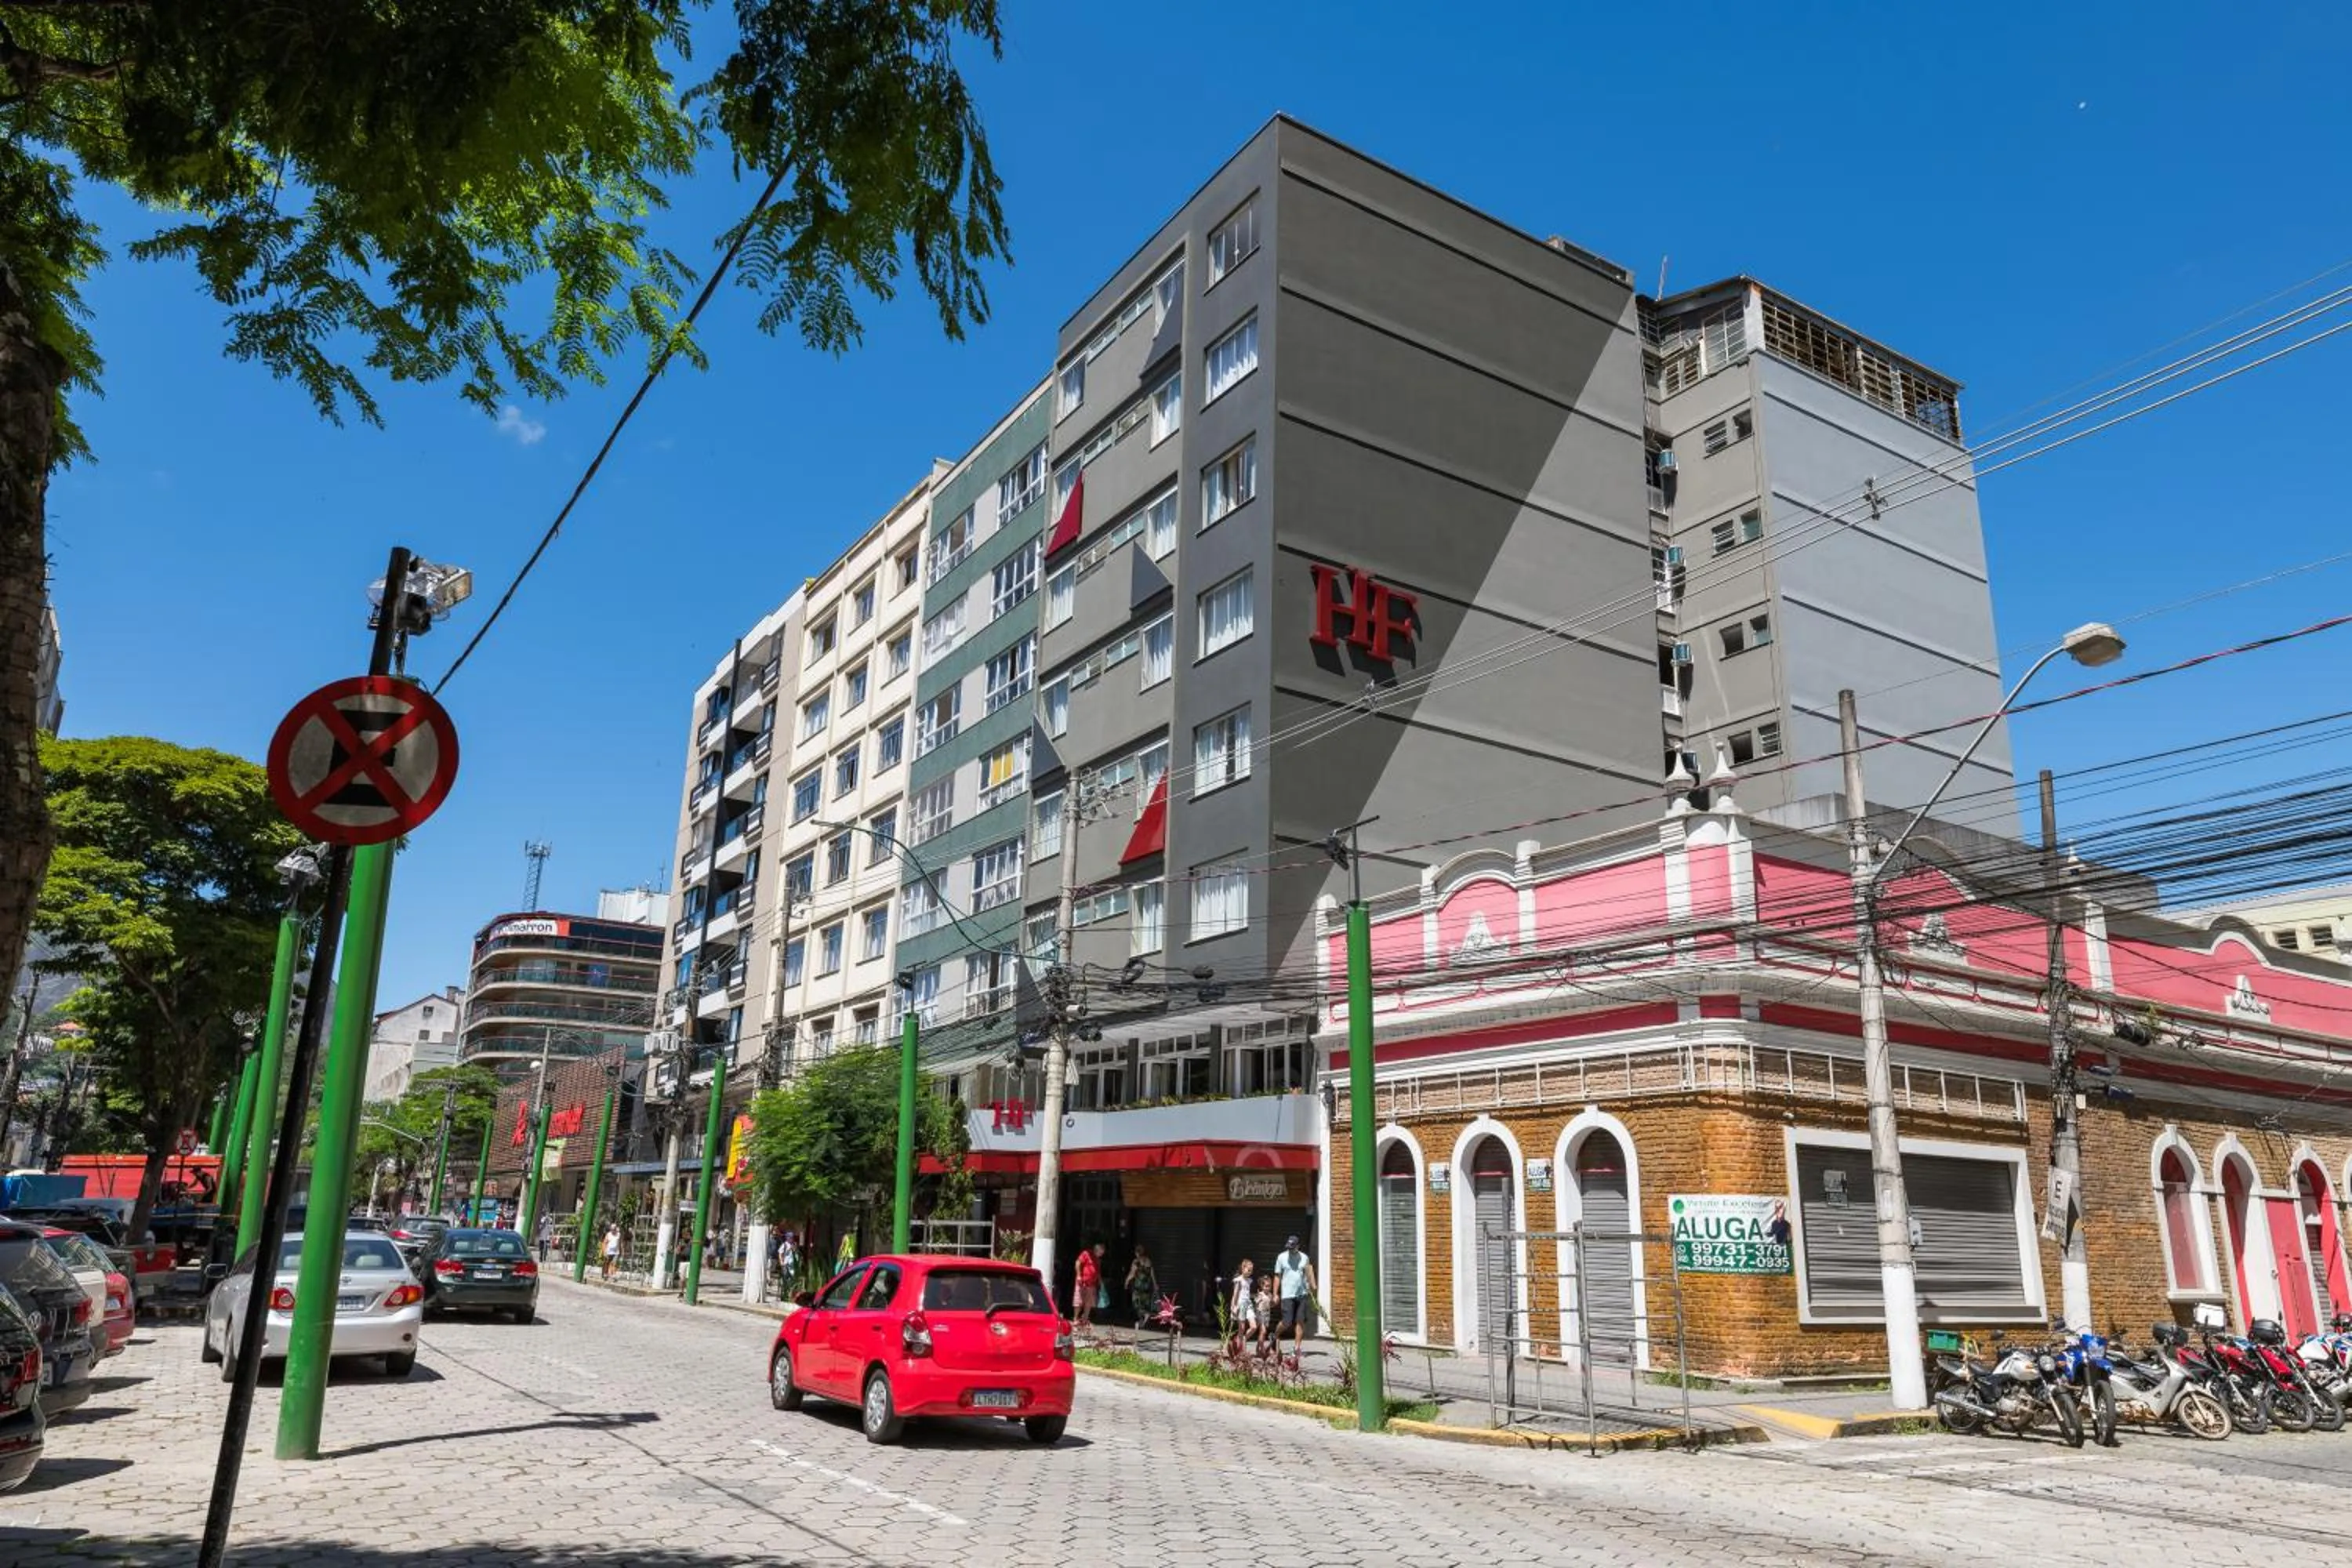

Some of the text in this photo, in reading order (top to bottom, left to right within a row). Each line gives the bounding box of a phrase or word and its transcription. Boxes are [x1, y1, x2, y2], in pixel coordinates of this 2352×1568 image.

[1310, 564, 1417, 662] HF
[1675, 1216, 1764, 1240] ALUGA
[1690, 1242, 1788, 1257] 99731-3791
